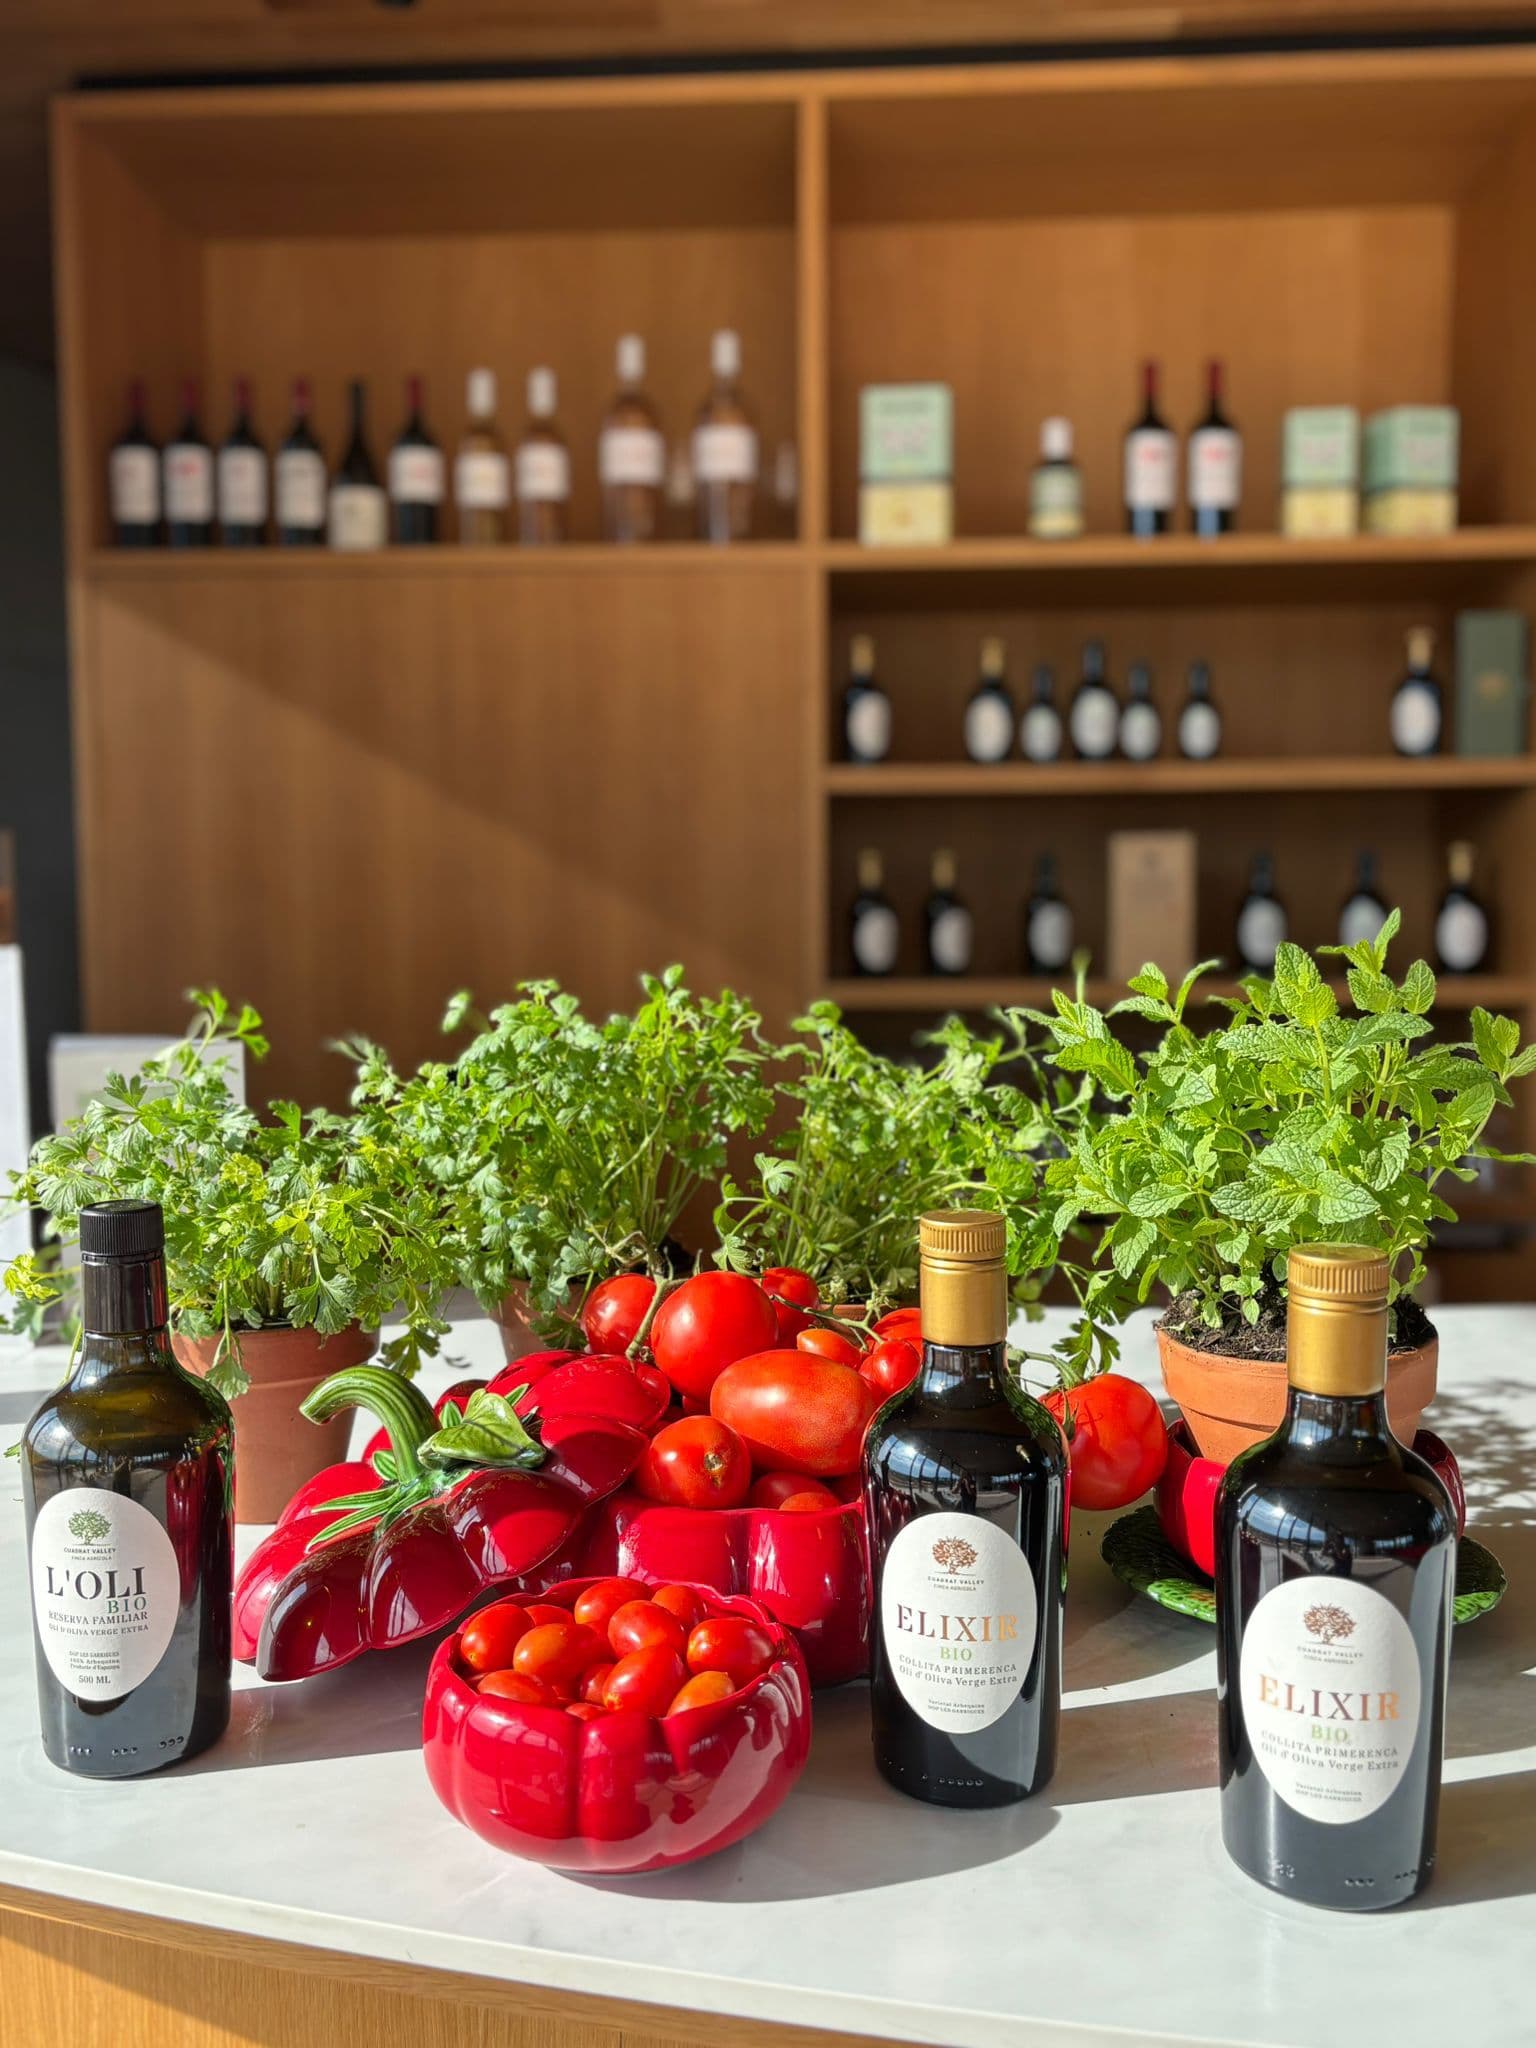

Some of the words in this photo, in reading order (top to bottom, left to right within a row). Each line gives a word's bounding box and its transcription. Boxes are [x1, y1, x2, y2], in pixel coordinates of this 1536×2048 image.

[46, 1565, 146, 1600] L'OLI
[107, 1596, 147, 1614] BIO
[48, 1610, 90, 1625] RESERVA
[92, 1611, 148, 1625] FAMILIAR
[896, 1603, 1018, 1642] ELIXIR
[90, 1626, 119, 1636] VERGE
[121, 1624, 149, 1635] EXTRA
[899, 1653, 941, 1673] COLLITA
[944, 1663, 1017, 1675] PRIMERENCA
[940, 1646, 972, 1661] BIO
[78, 1675, 94, 1684] 500
[96, 1675, 111, 1684] ML
[899, 1665, 913, 1677] Oli
[924, 1672, 953, 1685] Oliva
[956, 1677, 987, 1688] Verge
[990, 1675, 1018, 1686] Extra
[1259, 1673, 1400, 1721] ELIXIR
[1311, 1723, 1349, 1742] BIO
[1261, 1729, 1312, 1753] COLLITA
[1315, 1746, 1398, 1760] PRIMERENCA
[1261, 1742, 1277, 1755] Oli
[1291, 1752, 1325, 1767] Oliva
[1328, 1760, 1364, 1772] Verge
[1367, 1760, 1399, 1770] Extra
